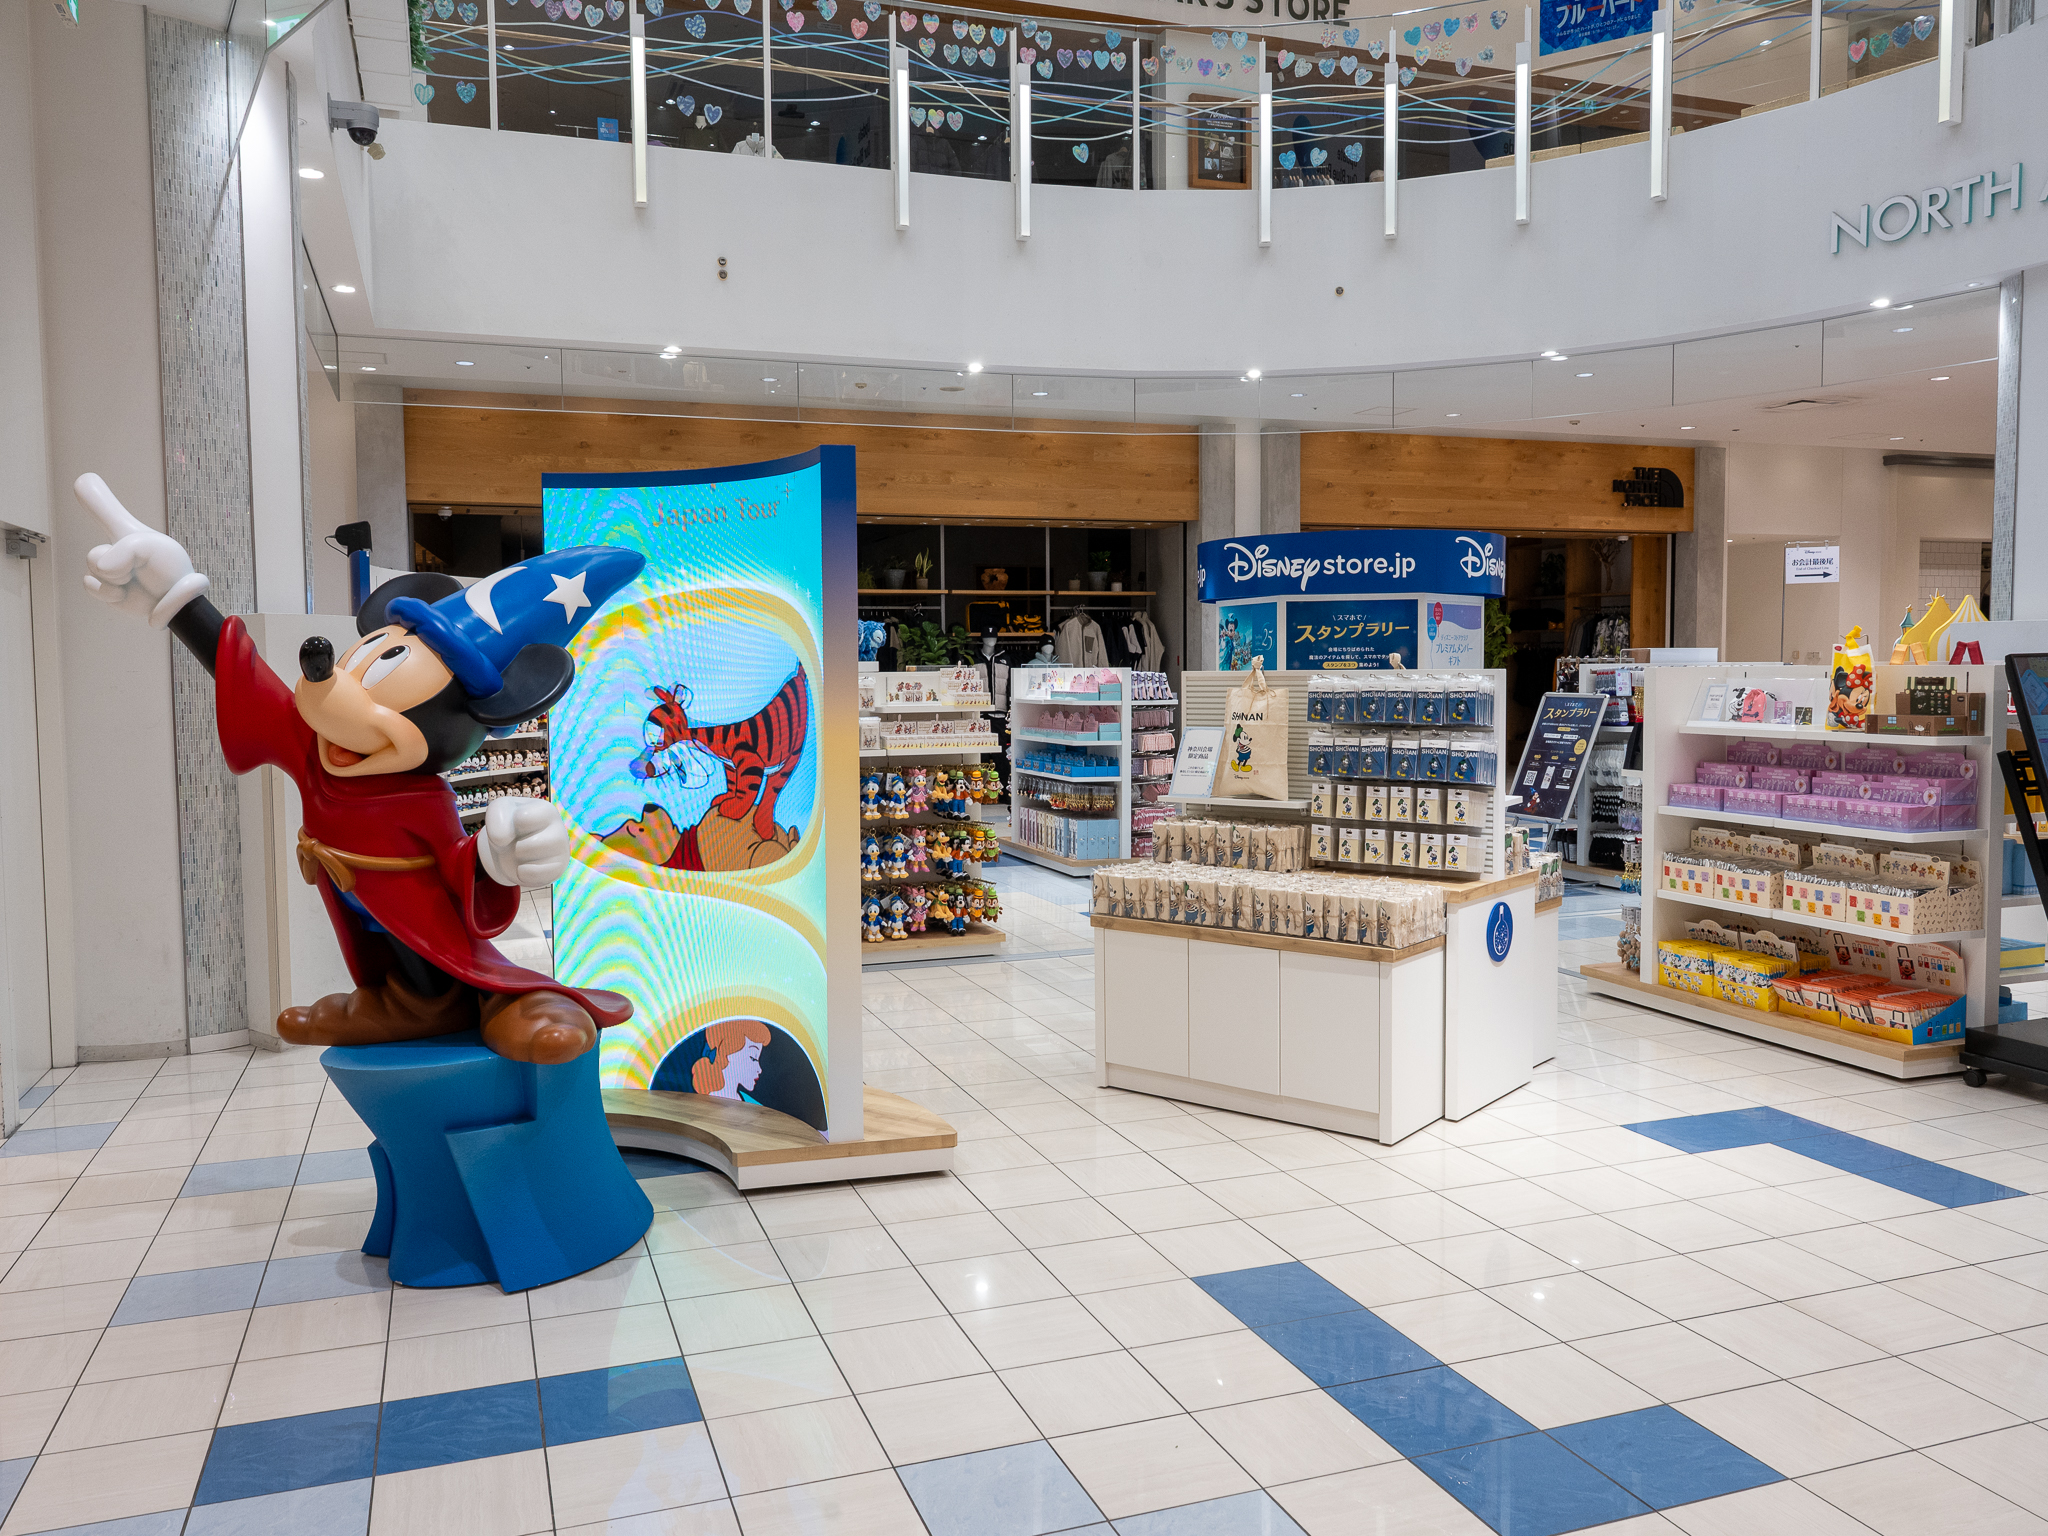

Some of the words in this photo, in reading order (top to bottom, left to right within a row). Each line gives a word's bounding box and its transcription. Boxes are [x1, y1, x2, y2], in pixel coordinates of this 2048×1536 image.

[1831, 162, 2023, 254] NORTH
[1632, 467, 1660, 479] THE
[1612, 479, 1661, 493] NORTH
[1625, 493, 1661, 507] FACE
[653, 503, 726, 532] Japan
[735, 497, 780, 521] Tour
[1323, 552, 1416, 578] store.jp
[1791, 558, 1834, 567] お会計最後尾
[1294, 622, 1410, 644] スタンプラリー
